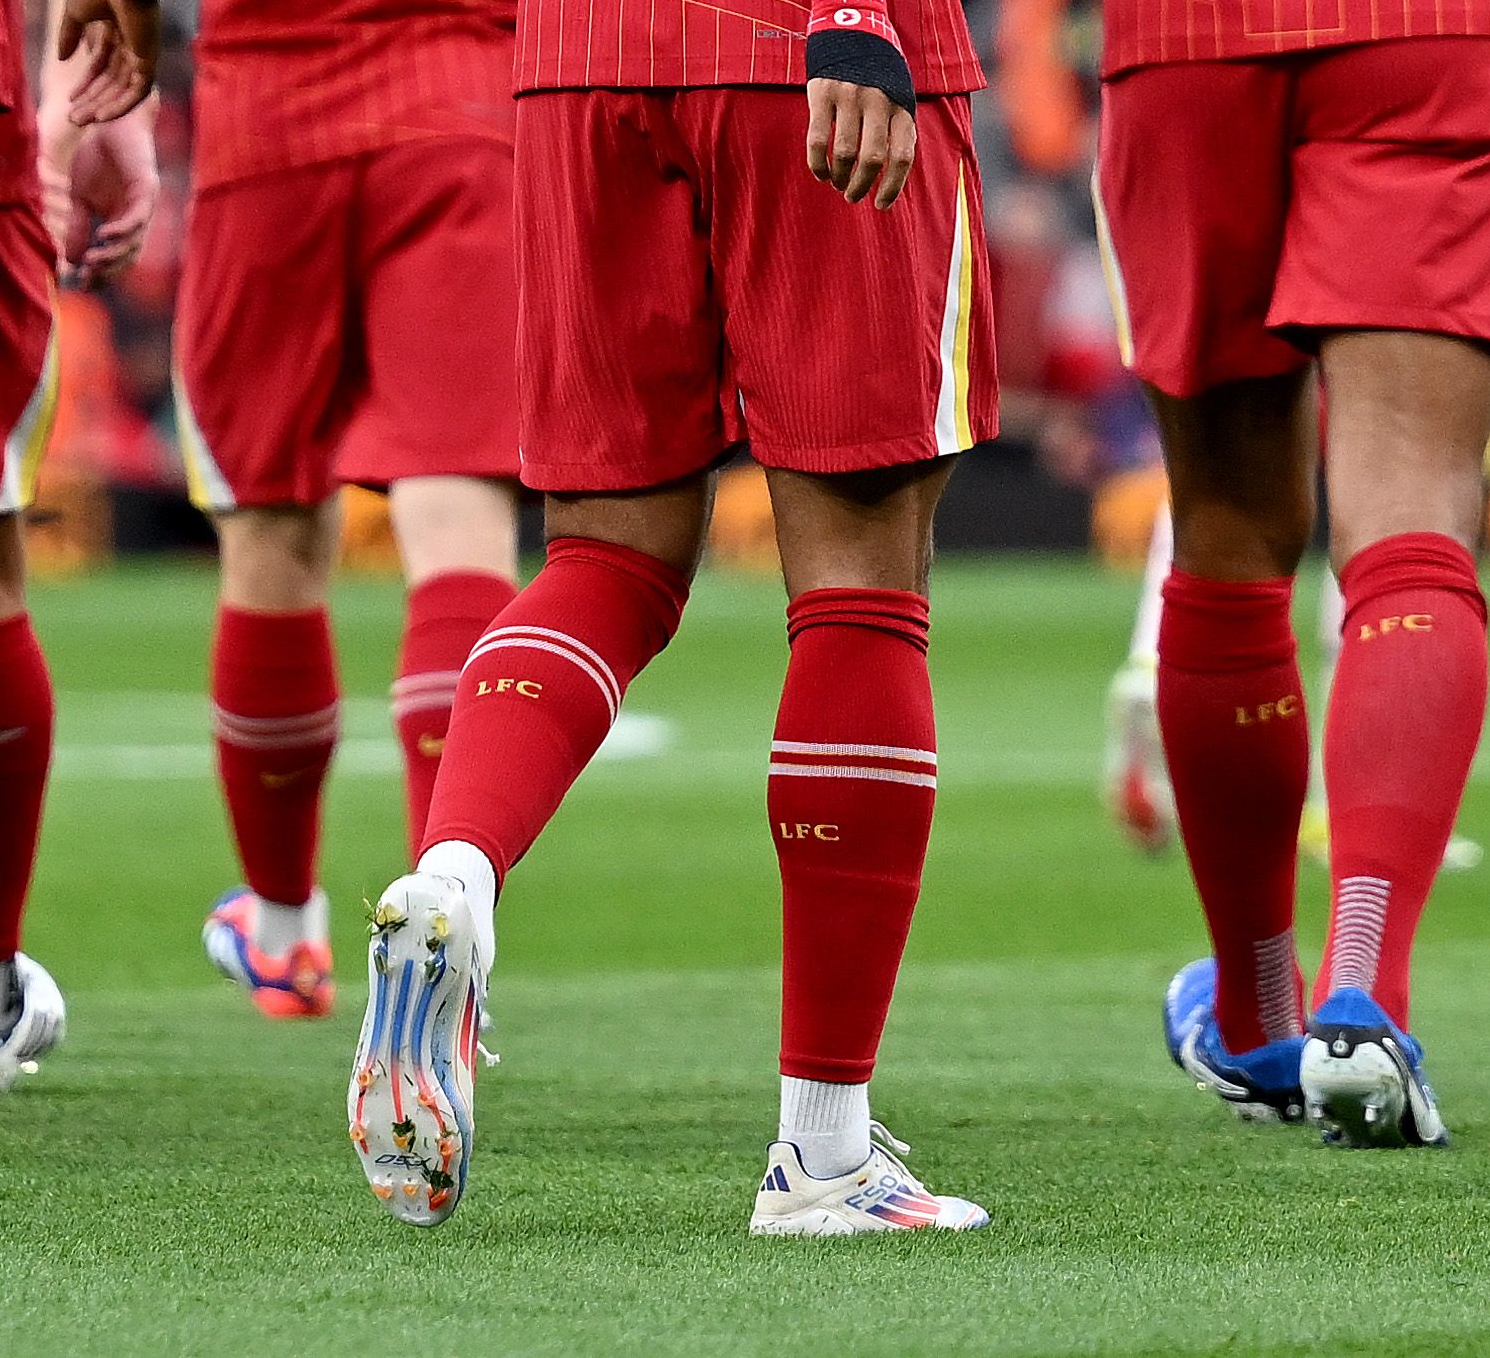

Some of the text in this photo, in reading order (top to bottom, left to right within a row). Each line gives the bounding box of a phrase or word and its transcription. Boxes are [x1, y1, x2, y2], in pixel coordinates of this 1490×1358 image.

[1359, 613, 1433, 641] LFC
[476, 678, 543, 699] LFC
[1235, 695, 1298, 727] LFC
[780, 822, 840, 843] LFC
